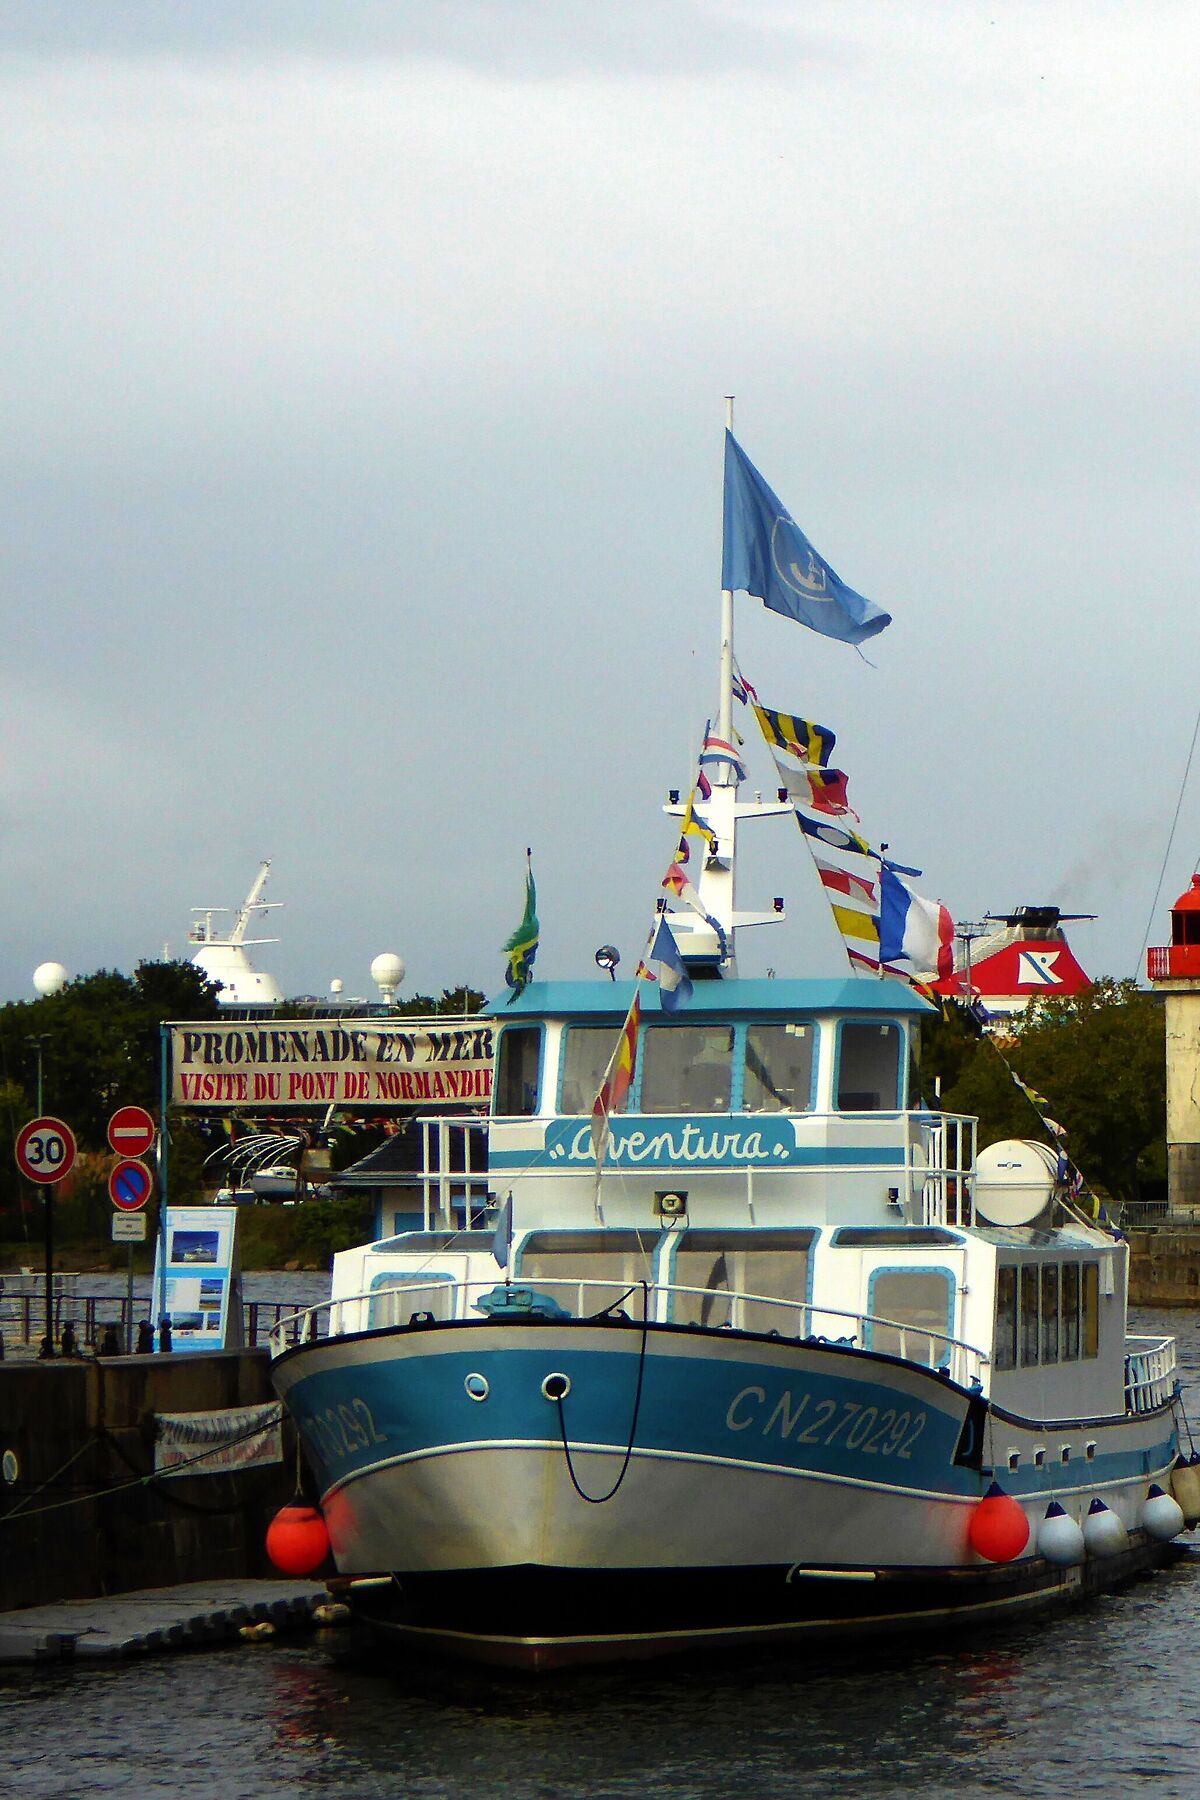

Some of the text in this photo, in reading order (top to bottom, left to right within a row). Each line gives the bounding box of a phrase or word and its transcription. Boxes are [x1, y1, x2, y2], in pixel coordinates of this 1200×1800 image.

[181, 1027, 495, 1064] PROMENADE EN MER
[180, 1072, 248, 1101] VISITE
[254, 1072, 282, 1101] DU
[288, 1071, 339, 1101] PONT
[344, 1071, 370, 1100] DE
[27, 1136, 64, 1165] 30
